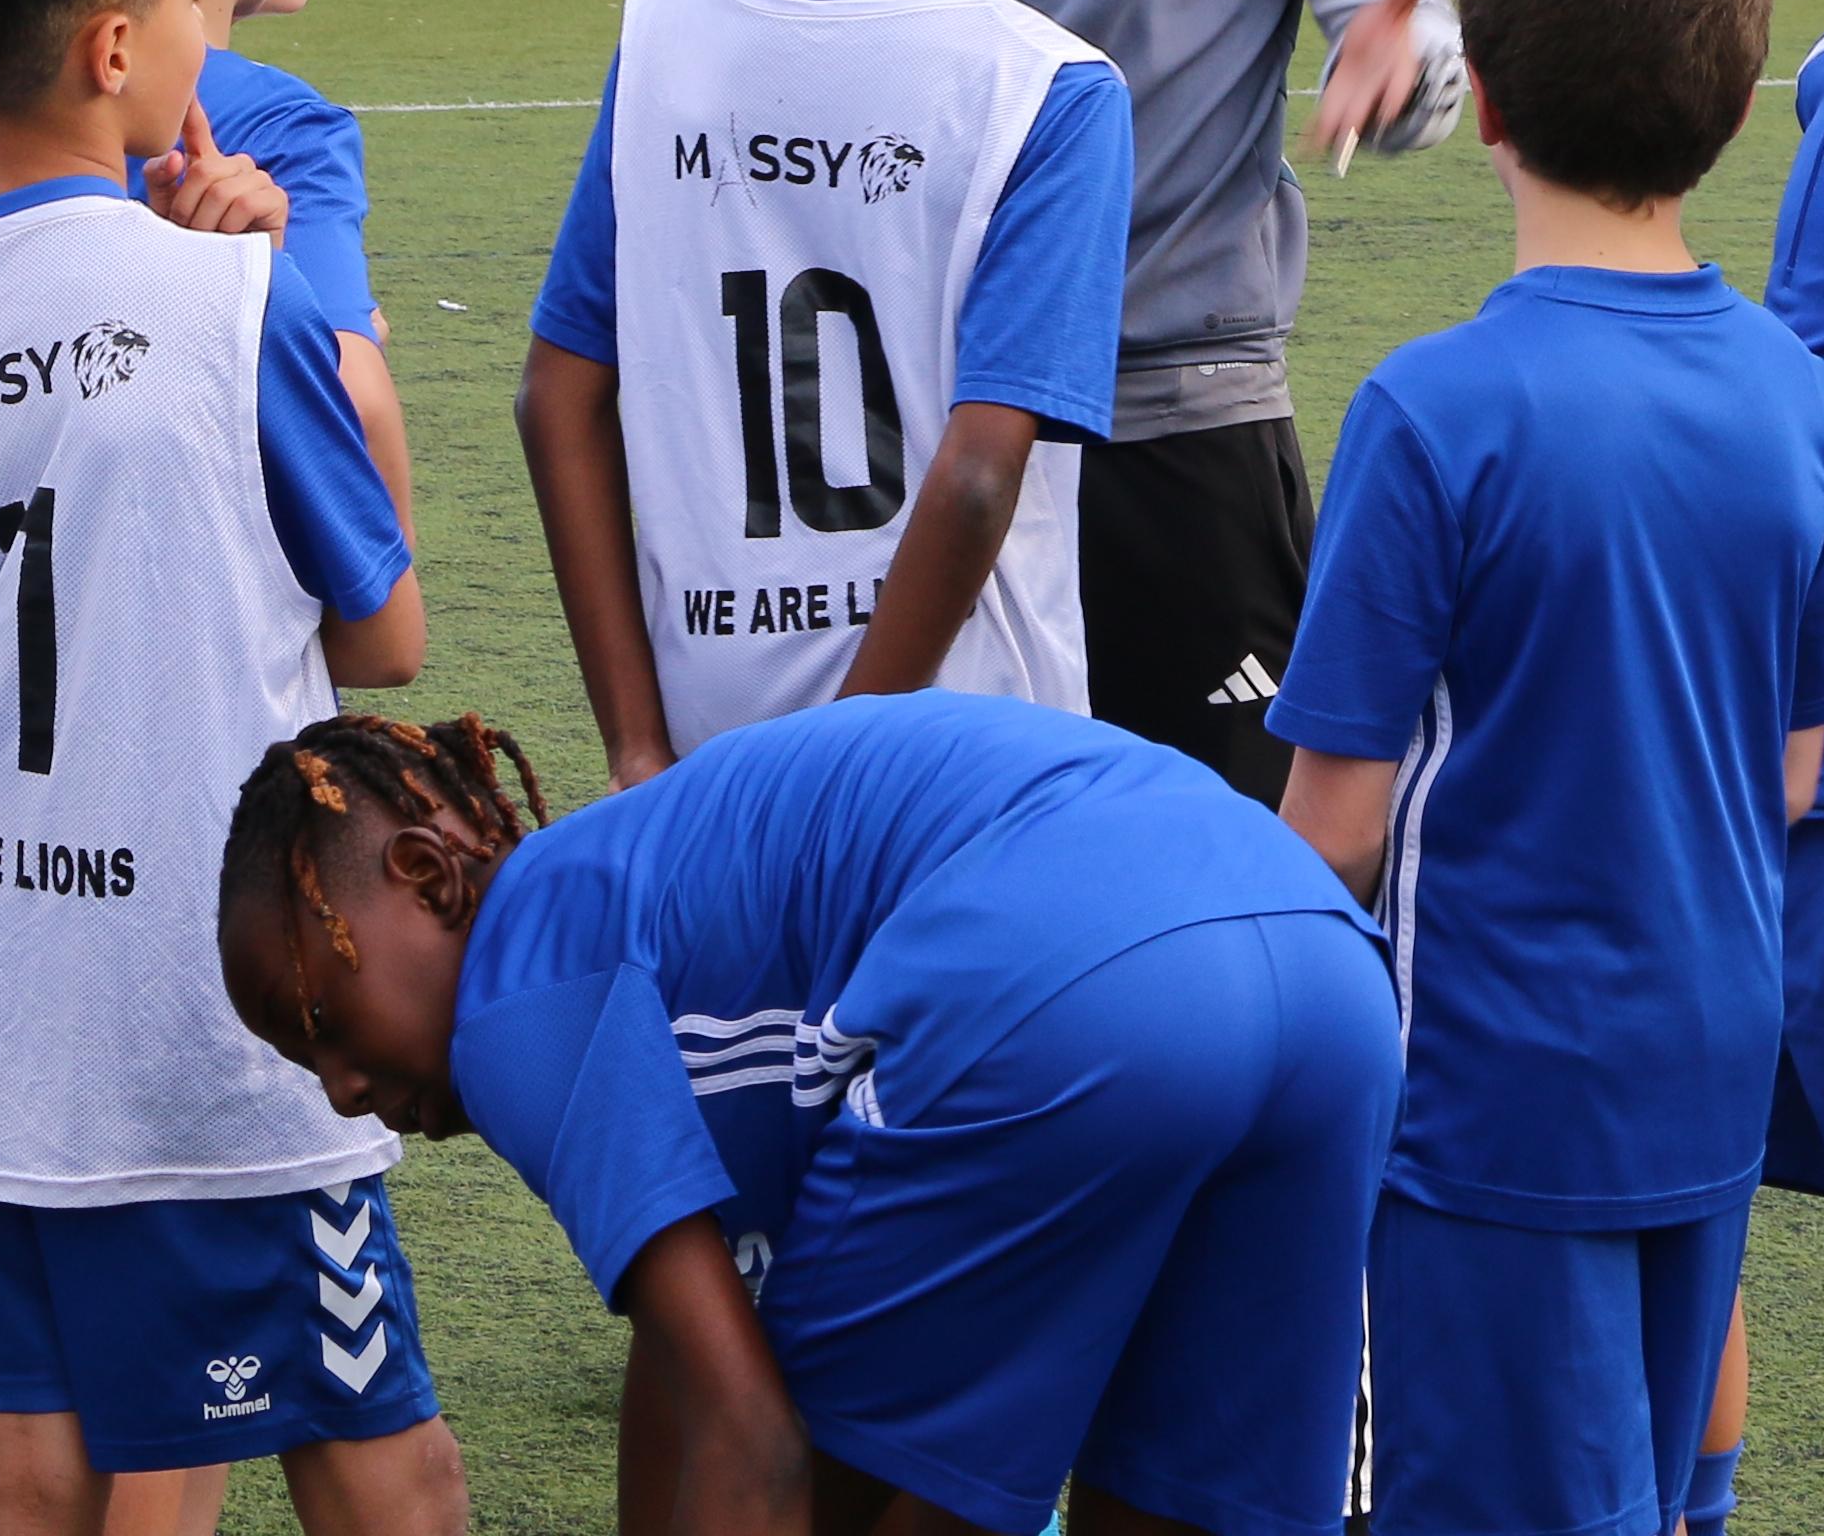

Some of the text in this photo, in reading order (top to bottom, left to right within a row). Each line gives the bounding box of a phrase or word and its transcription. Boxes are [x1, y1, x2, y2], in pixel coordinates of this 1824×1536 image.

[675, 112, 854, 209] MASSY
[721, 267, 905, 539] 10
[684, 590, 735, 635] WE
[749, 584, 831, 634] ARE
[15, 839, 135, 898] LIONS
[203, 1392, 271, 1421] hummel
